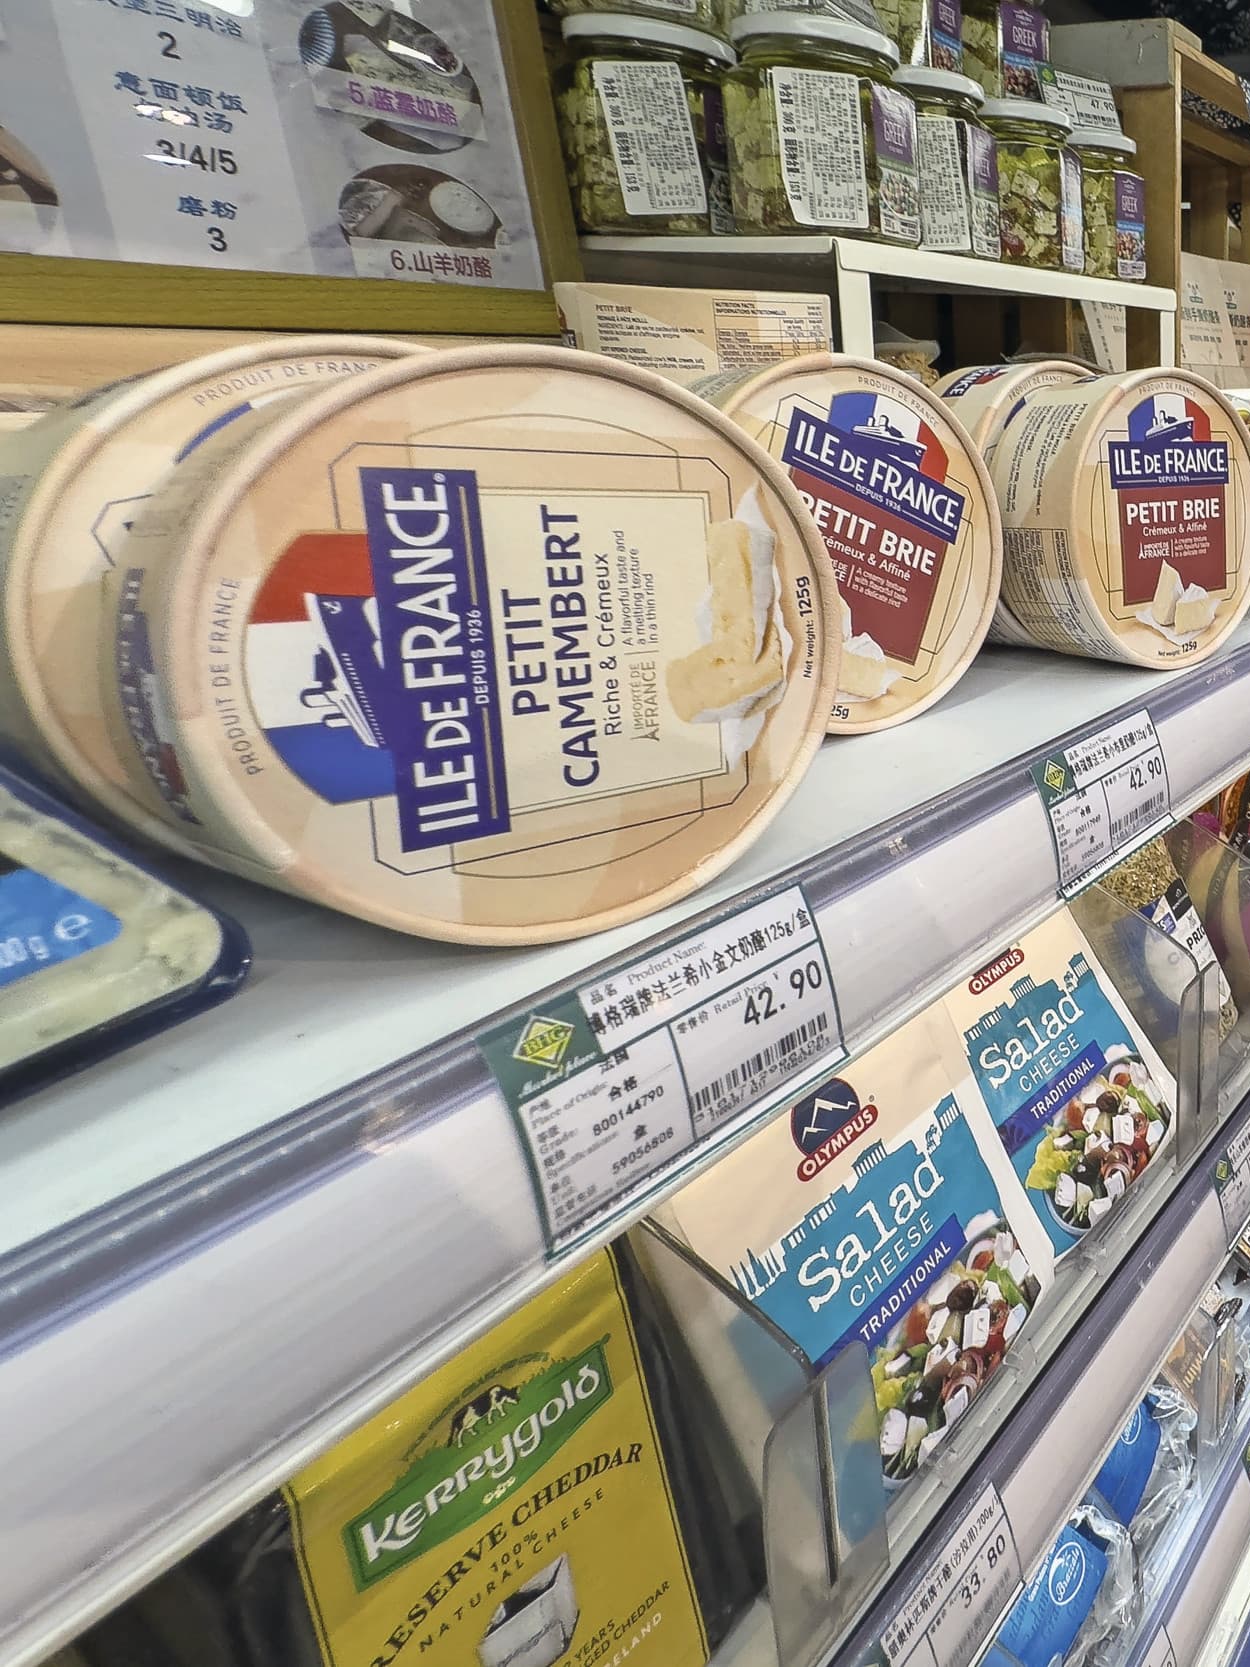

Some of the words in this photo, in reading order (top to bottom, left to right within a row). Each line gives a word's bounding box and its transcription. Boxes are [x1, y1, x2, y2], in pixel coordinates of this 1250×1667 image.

[158, 31, 181, 60] 2
[1012, 25, 1038, 49] GREEK
[207, 226, 228, 254] 3
[193, 368, 274, 407] PRODUIT
[283, 362, 308, 379] DE
[857, 375, 897, 396] PRODUIT
[898, 392, 909, 404] DE
[910, 401, 939, 428] FRANCE
[794, 420, 839, 466] ILE
[839, 451, 867, 481] DE
[869, 460, 961, 531] FRANCE
[1114, 448, 1142, 476] ILE
[1144, 456, 1162, 474] DE
[1164, 448, 1228, 475] FRANCE
[855, 483, 885, 503] DEPUIS
[1126, 500, 1177, 525] PETIT
[1183, 497, 1220, 521] BRIE
[612, 530, 626, 552] and
[879, 528, 937, 576] BRIE
[1143, 526, 1177, 537] Crémeux
[1179, 523, 1185, 533] &
[1186, 522, 1208, 532] Affiné
[615, 555, 629, 581] taste
[628, 548, 642, 591] texture
[820, 534, 866, 563] rémeux
[867, 552, 877, 566] &
[879, 559, 911, 581] Affiné
[382, 477, 470, 690] FRANCE
[594, 552, 616, 648] Crémeux
[643, 572, 656, 595] rind
[797, 575, 813, 618] 125g
[208, 577, 241, 654] FRANCE
[466, 606, 484, 645] 1936
[630, 592, 646, 635] melting
[646, 599, 658, 622] thin
[501, 588, 552, 717] PETIT
[538, 504, 602, 787] CAMEMBERT
[599, 655, 619, 671] &
[803, 619, 815, 660] weight:
[1181, 641, 1198, 653] 125g
[209, 663, 233, 688] DE
[470, 645, 491, 706] DEPUIS
[630, 662, 641, 676] DE
[802, 659, 814, 679] Net
[426, 697, 472, 754] DE
[602, 677, 623, 737] Riche
[830, 703, 849, 720] 25g
[215, 697, 265, 776] PRODUIT
[413, 752, 480, 836] ILE
[1128, 756, 1162, 791] 42.90
[627, 954, 673, 986] Product
[743, 960, 822, 1026] 42.90
[970, 948, 1025, 996] OLYMPUS
[978, 988, 1086, 1090] Salad
[1018, 1033, 1082, 1094] CHEESE
[607, 1075, 638, 1102] 合格
[1029, 1056, 1097, 1121] TRADITIONAL
[801, 1108, 876, 1179] OLYMPUS
[797, 1155, 948, 1314] Salad
[848, 1211, 935, 1309] CHEESE
[858, 1239, 953, 1344] TRADITIONAL
[358, 1363, 602, 1565] Kerrygold
[510, 1442, 644, 1529] CHEDDAR
[417, 1557, 525, 1653] NATURAL
[532, 1488, 606, 1555] CHEESE
[489, 1529, 539, 1573] 100%
[962, 1533, 1006, 1609] 33.80
[612, 1579, 672, 1644] CHEDDAR
[574, 1617, 618, 1667] YEARS
